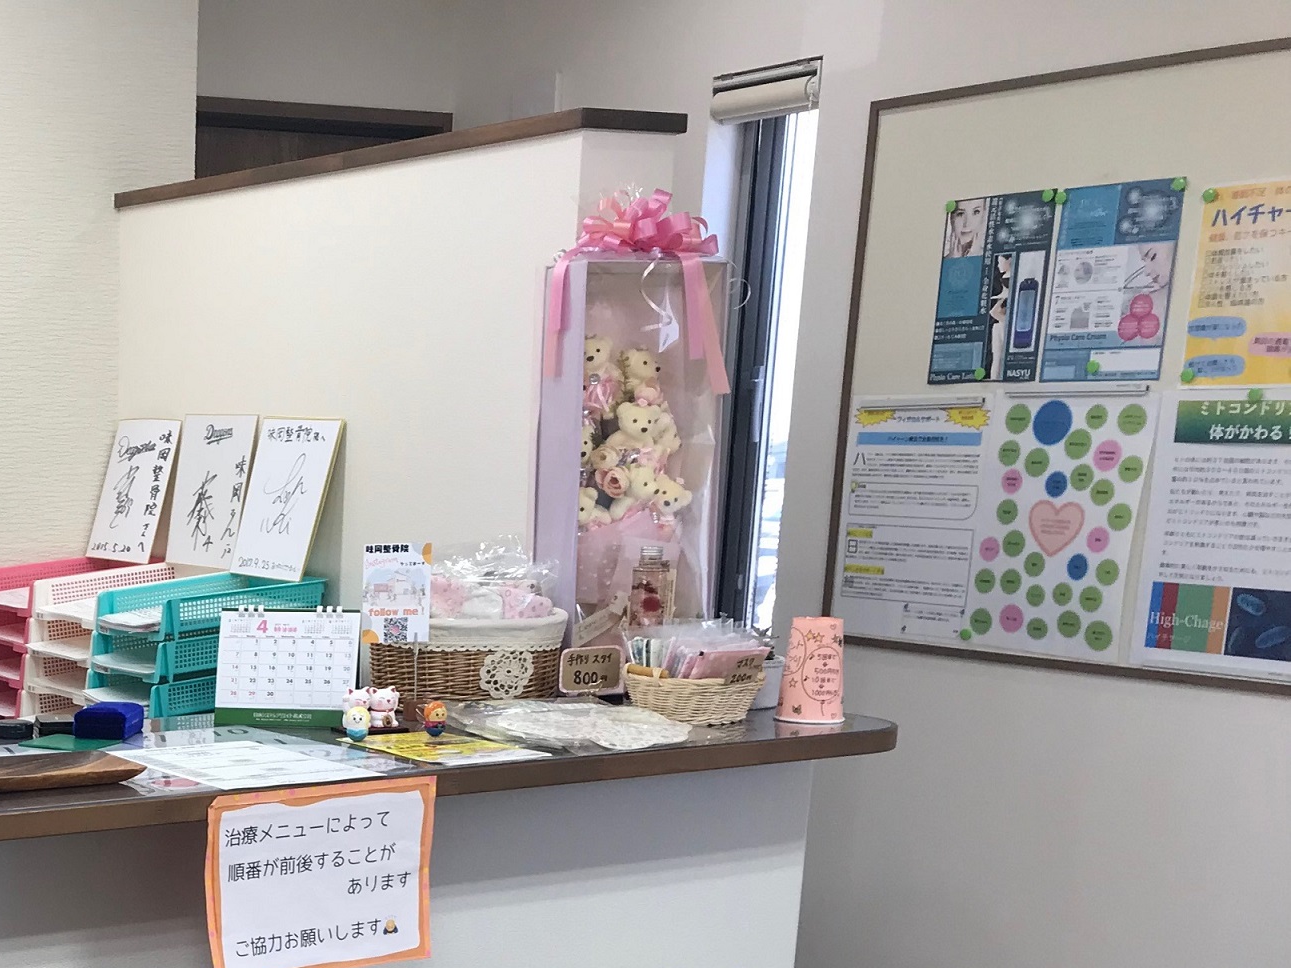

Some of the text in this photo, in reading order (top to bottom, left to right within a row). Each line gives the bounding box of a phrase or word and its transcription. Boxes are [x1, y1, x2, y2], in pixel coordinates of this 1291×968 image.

[1201, 401, 1291, 416] ミトコンドリ
[368, 608, 419, 617] follow me
[257, 620, 268, 633] 4
[225, 811, 390, 847] 治療メニューによって
[228, 843, 396, 882] 順番が前後することが
[348, 871, 411, 894] あります
[236, 918, 381, 957] ご協力お願いします
